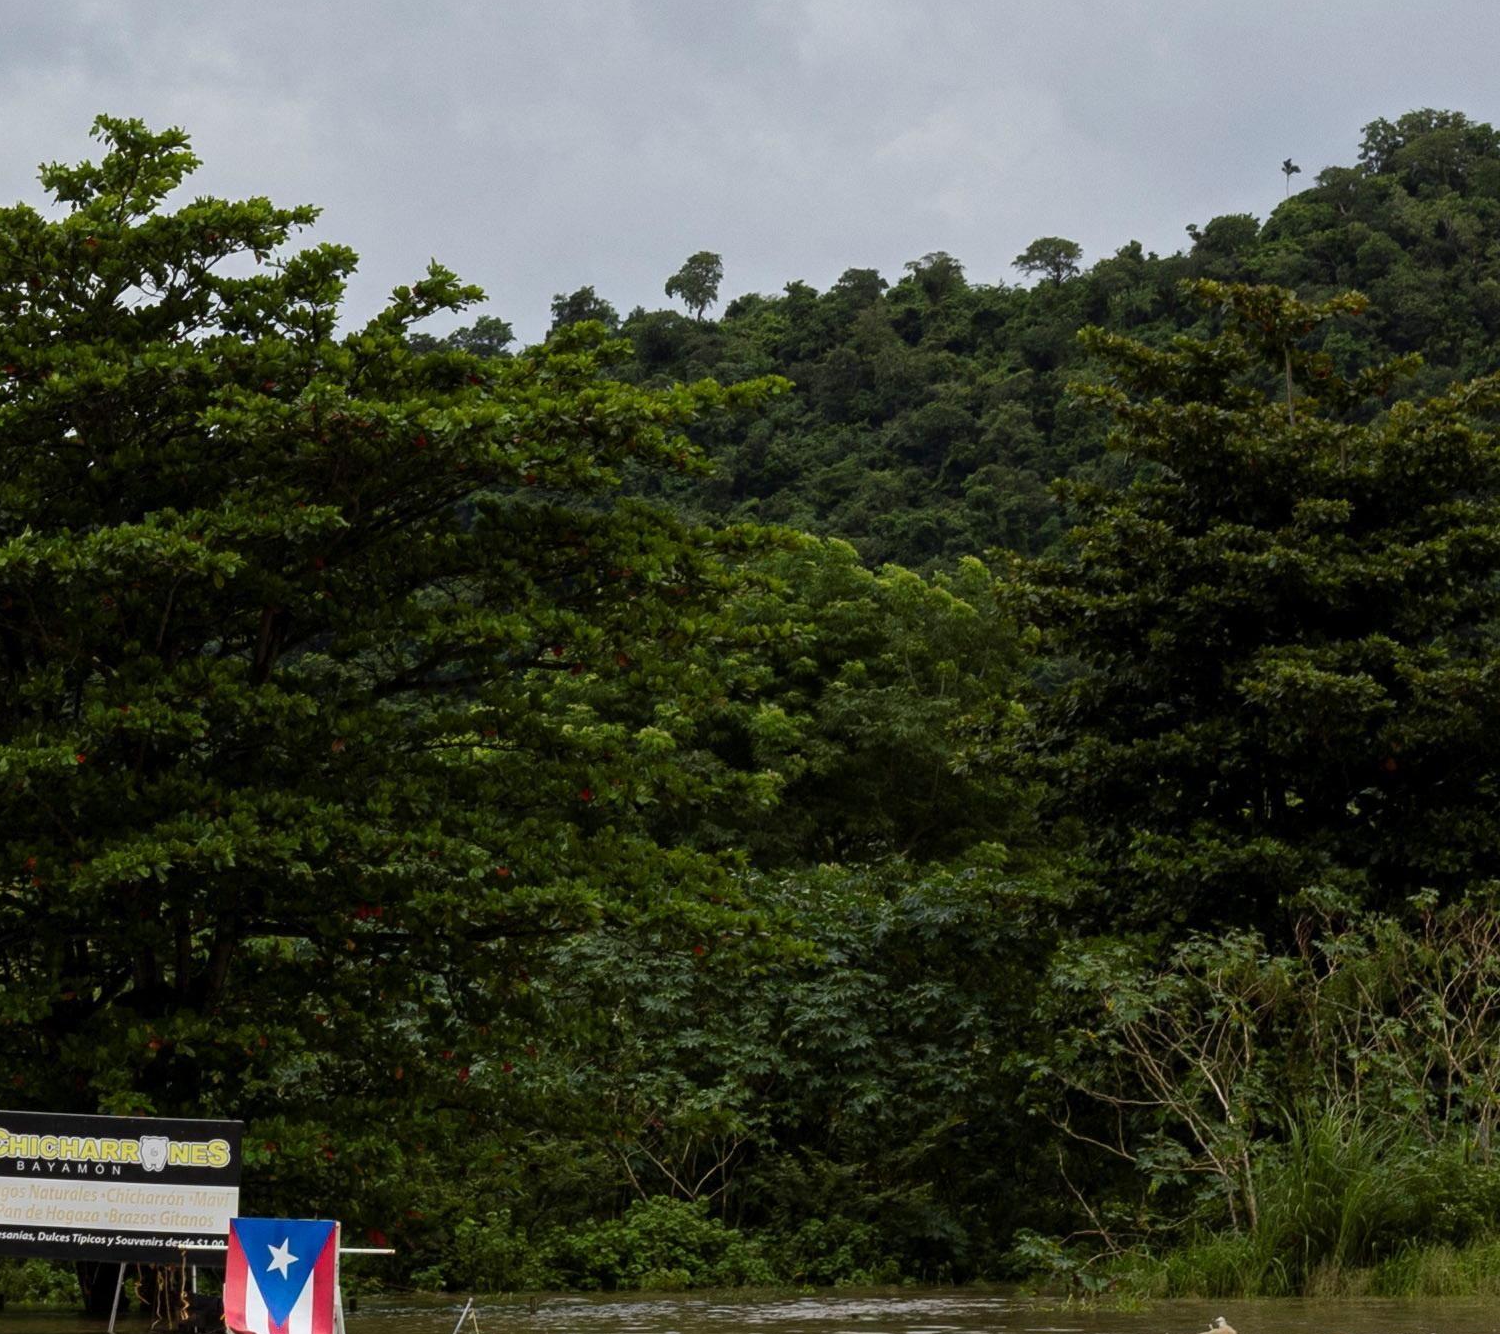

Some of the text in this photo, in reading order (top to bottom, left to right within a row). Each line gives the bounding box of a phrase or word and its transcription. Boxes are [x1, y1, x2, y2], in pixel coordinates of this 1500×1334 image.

[16, 1160, 121, 1175] BAYAMÓN
[29, 1184, 98, 1202] Naturales
[106, 1188, 185, 1205] Chicharrón
[26, 1204, 41, 1219] de
[46, 1206, 100, 1225] Hogaza
[161, 1210, 214, 1227] Gitanos
[38, 1231, 70, 1243] Dulces
[107, 1237, 113, 1246] y
[115, 1235, 164, 1247] Souvenirs
[165, 1238, 194, 1247] desde
